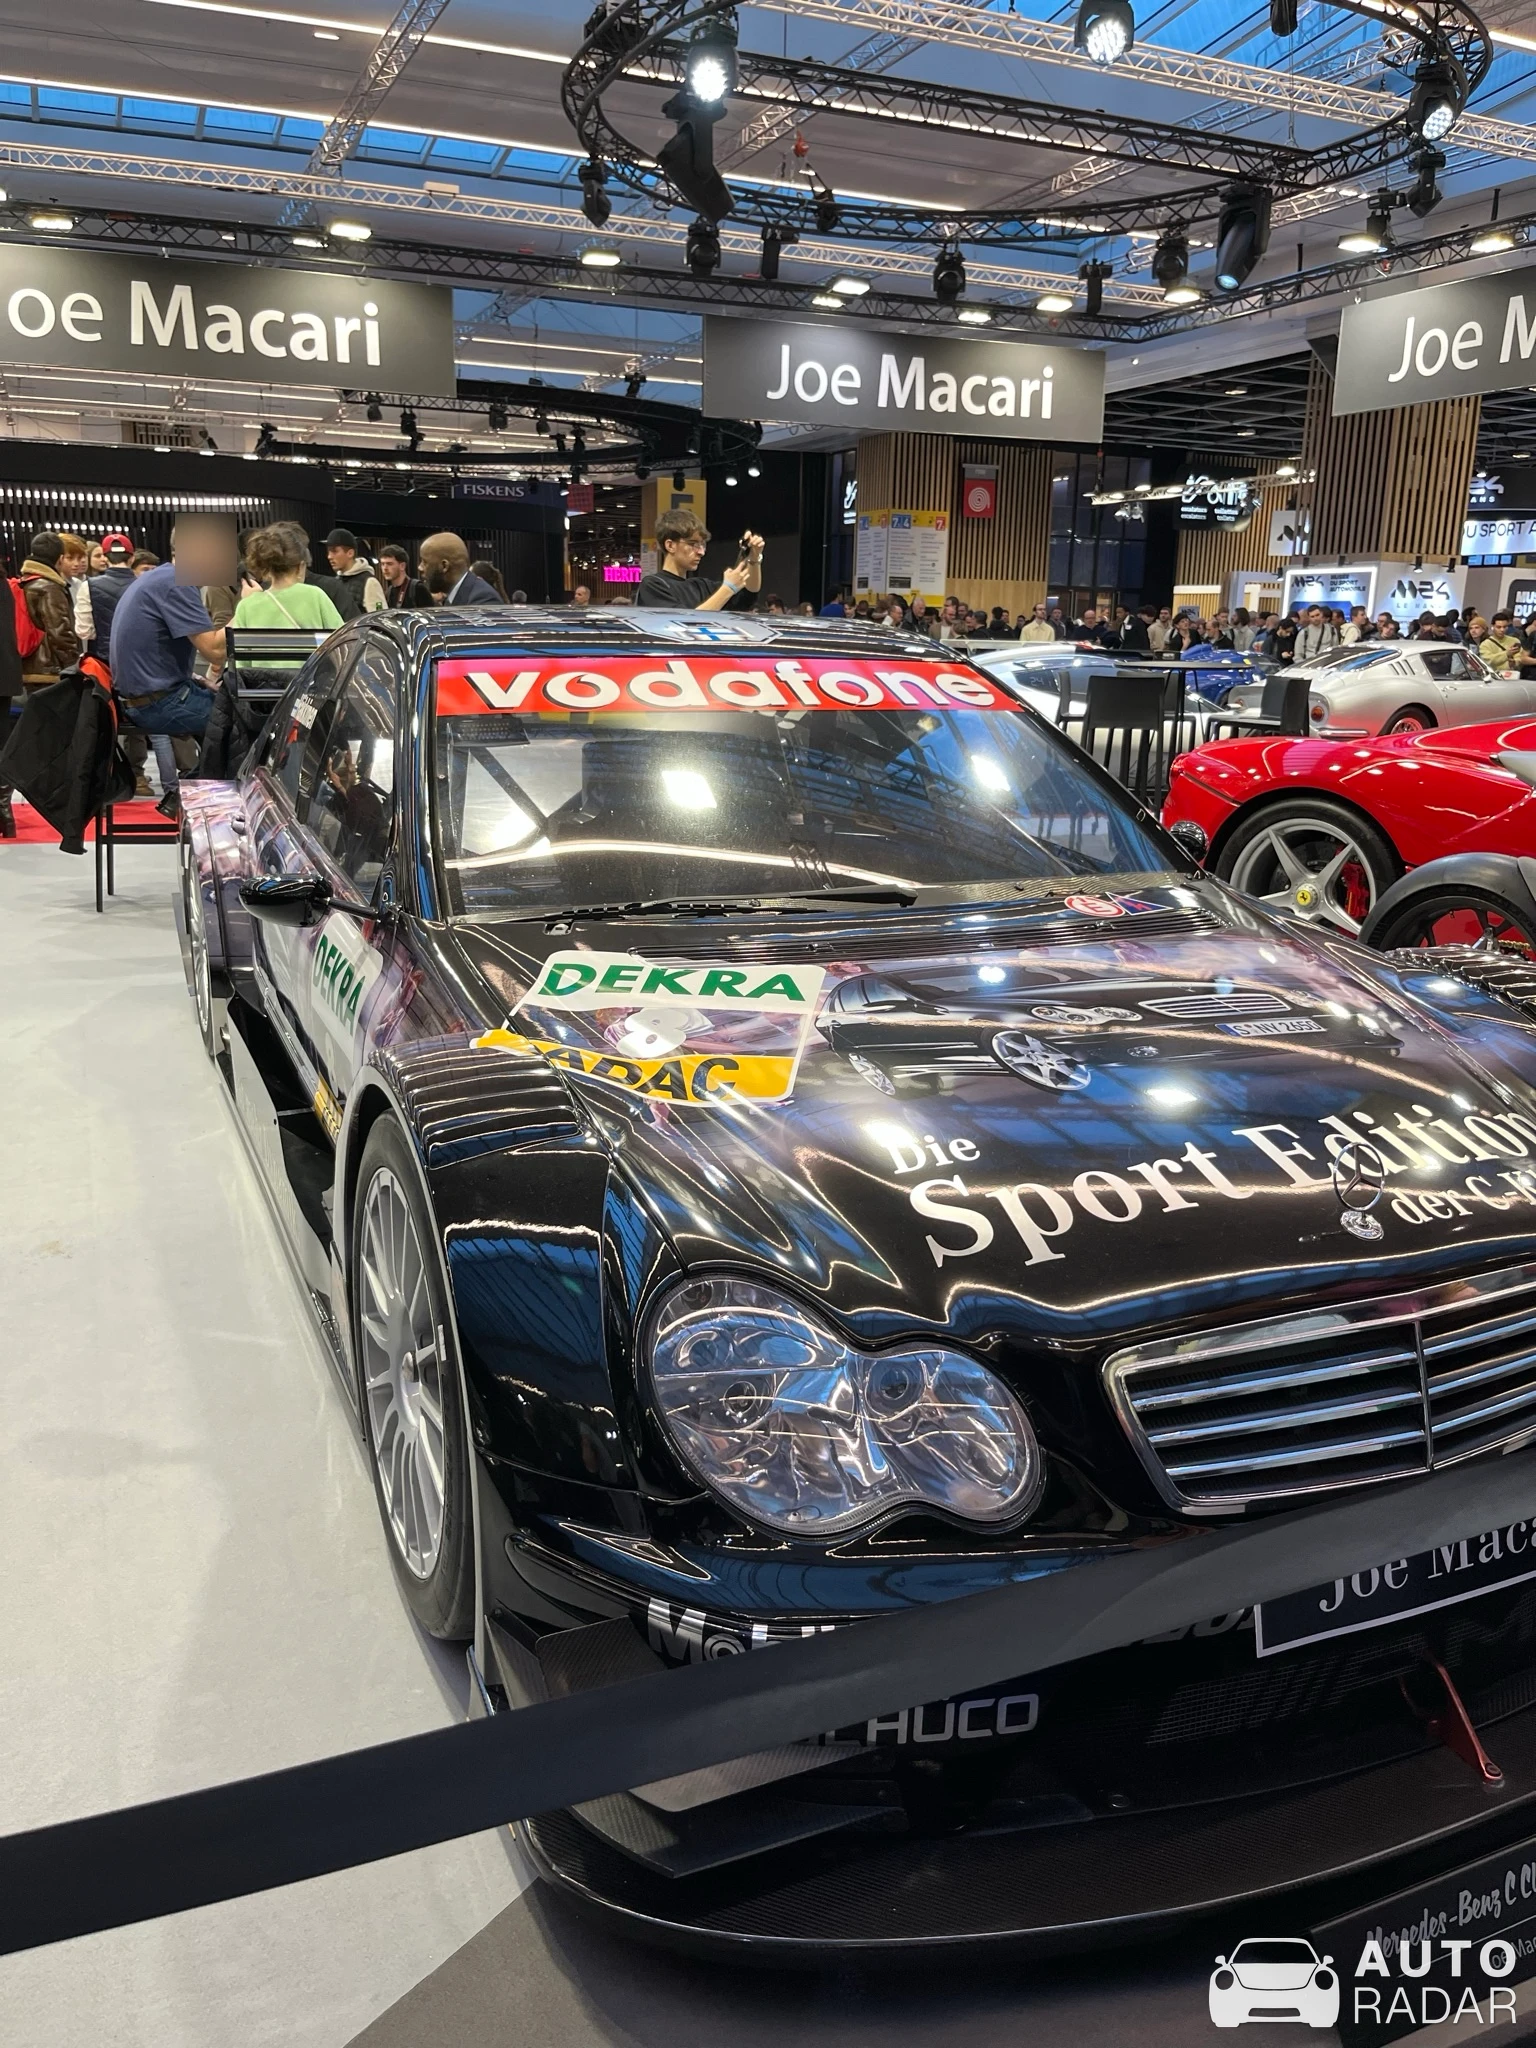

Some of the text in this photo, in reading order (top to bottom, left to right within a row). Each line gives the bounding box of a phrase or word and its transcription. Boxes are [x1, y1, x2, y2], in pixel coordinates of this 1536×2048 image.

[130, 280, 381, 367] Macari
[1388, 315, 1483, 383] Joe
[766, 343, 1053, 420] Joe Macari
[463, 484, 525, 497] FISKENS
[1464, 525, 1477, 538] U
[1480, 522, 1525, 537] SPORT
[1390, 579, 1450, 600] M24
[468, 660, 996, 710] vodafone
[313, 934, 366, 1036] DEKRA
[537, 963, 806, 1002] DEKRA
[616, 1007, 688, 1059] 8
[542, 1048, 739, 1101] ADAC
[886, 1135, 980, 1174] Die
[909, 1142, 1255, 1268] Sport
[1391, 1169, 1536, 1224] der C-K
[1319, 1557, 1408, 1612] Joe
[796, 1693, 1040, 1747] HUCO
[1504, 1870, 1517, 1905] C
